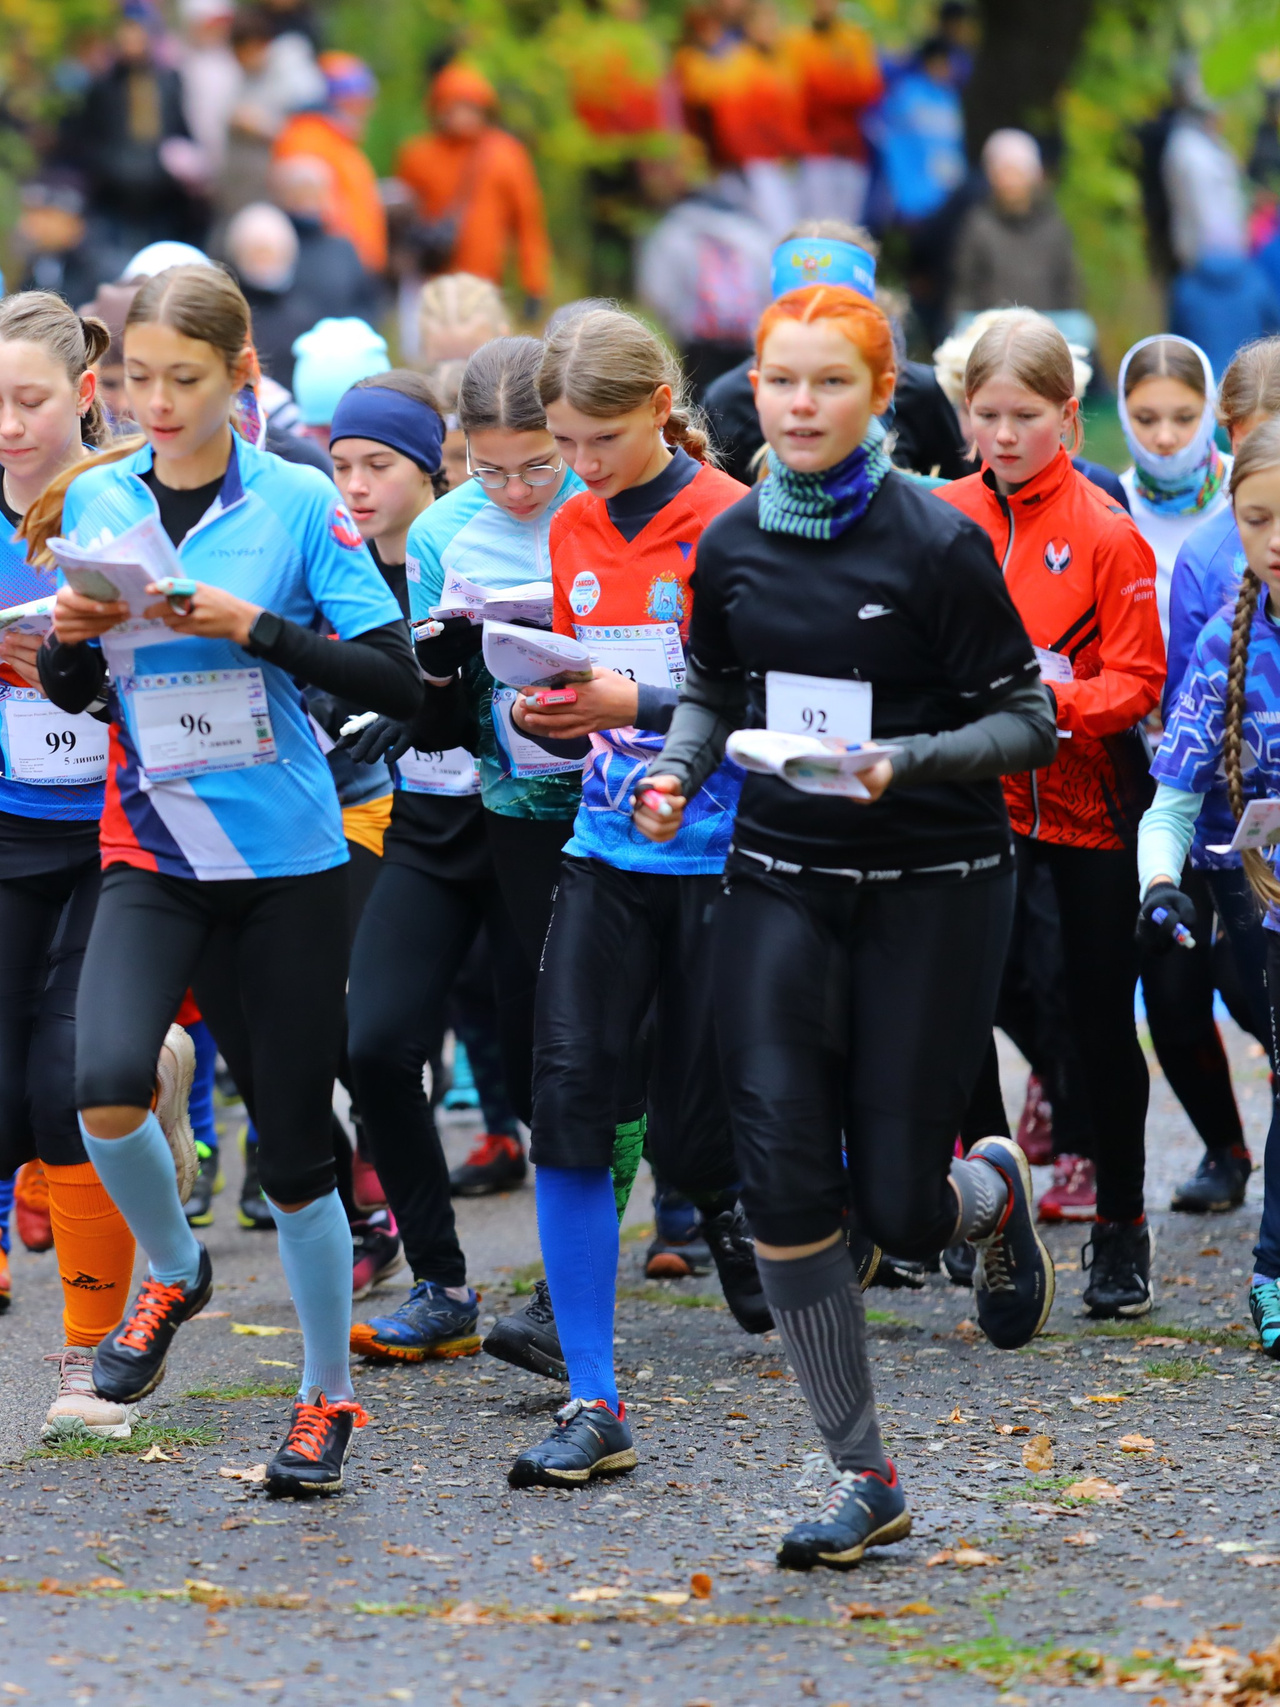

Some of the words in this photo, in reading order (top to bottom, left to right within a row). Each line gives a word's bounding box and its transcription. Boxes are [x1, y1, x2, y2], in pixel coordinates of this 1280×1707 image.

[180, 712, 212, 737] 96
[801, 707, 828, 733] 92
[45, 730, 77, 755] 99
[64, 757, 71, 765] 5
[73, 754, 105, 765] линия
[56, 775, 103, 785] СОРЕВНОВАНИЯ
